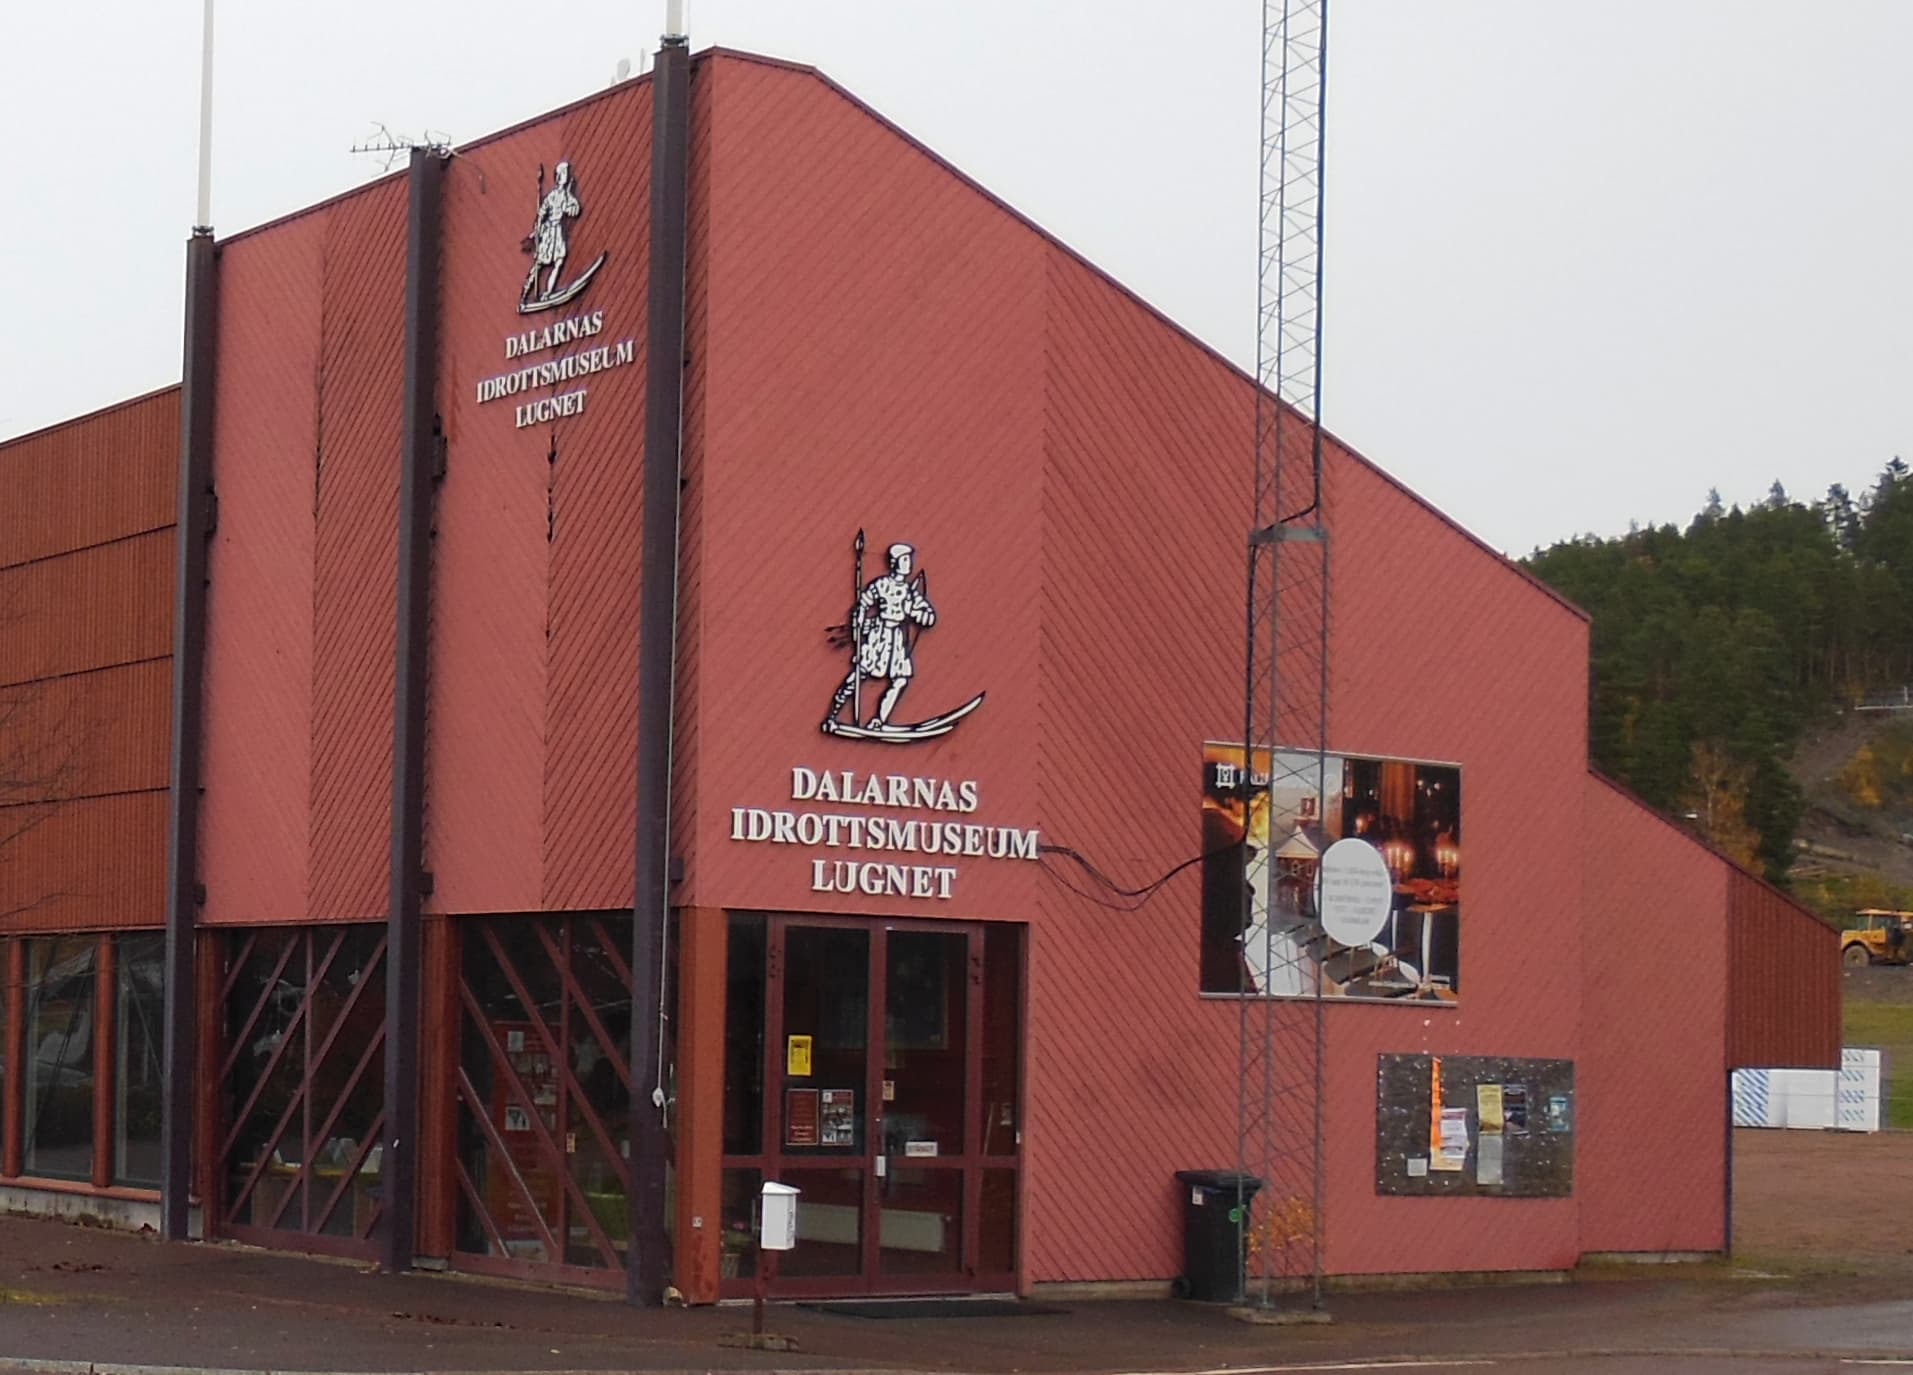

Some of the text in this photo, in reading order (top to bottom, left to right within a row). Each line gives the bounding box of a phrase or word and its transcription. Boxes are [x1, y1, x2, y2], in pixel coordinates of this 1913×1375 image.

[505, 311, 603, 360] DALARNAS
[476, 340, 635, 404] IDROTTSMUSEUM
[515, 390, 588, 428] LUGNET
[791, 767, 979, 812] DALARNAS
[731, 808, 1039, 860] IDROTTSMUSEUM
[812, 859, 957, 899] LUGNET
